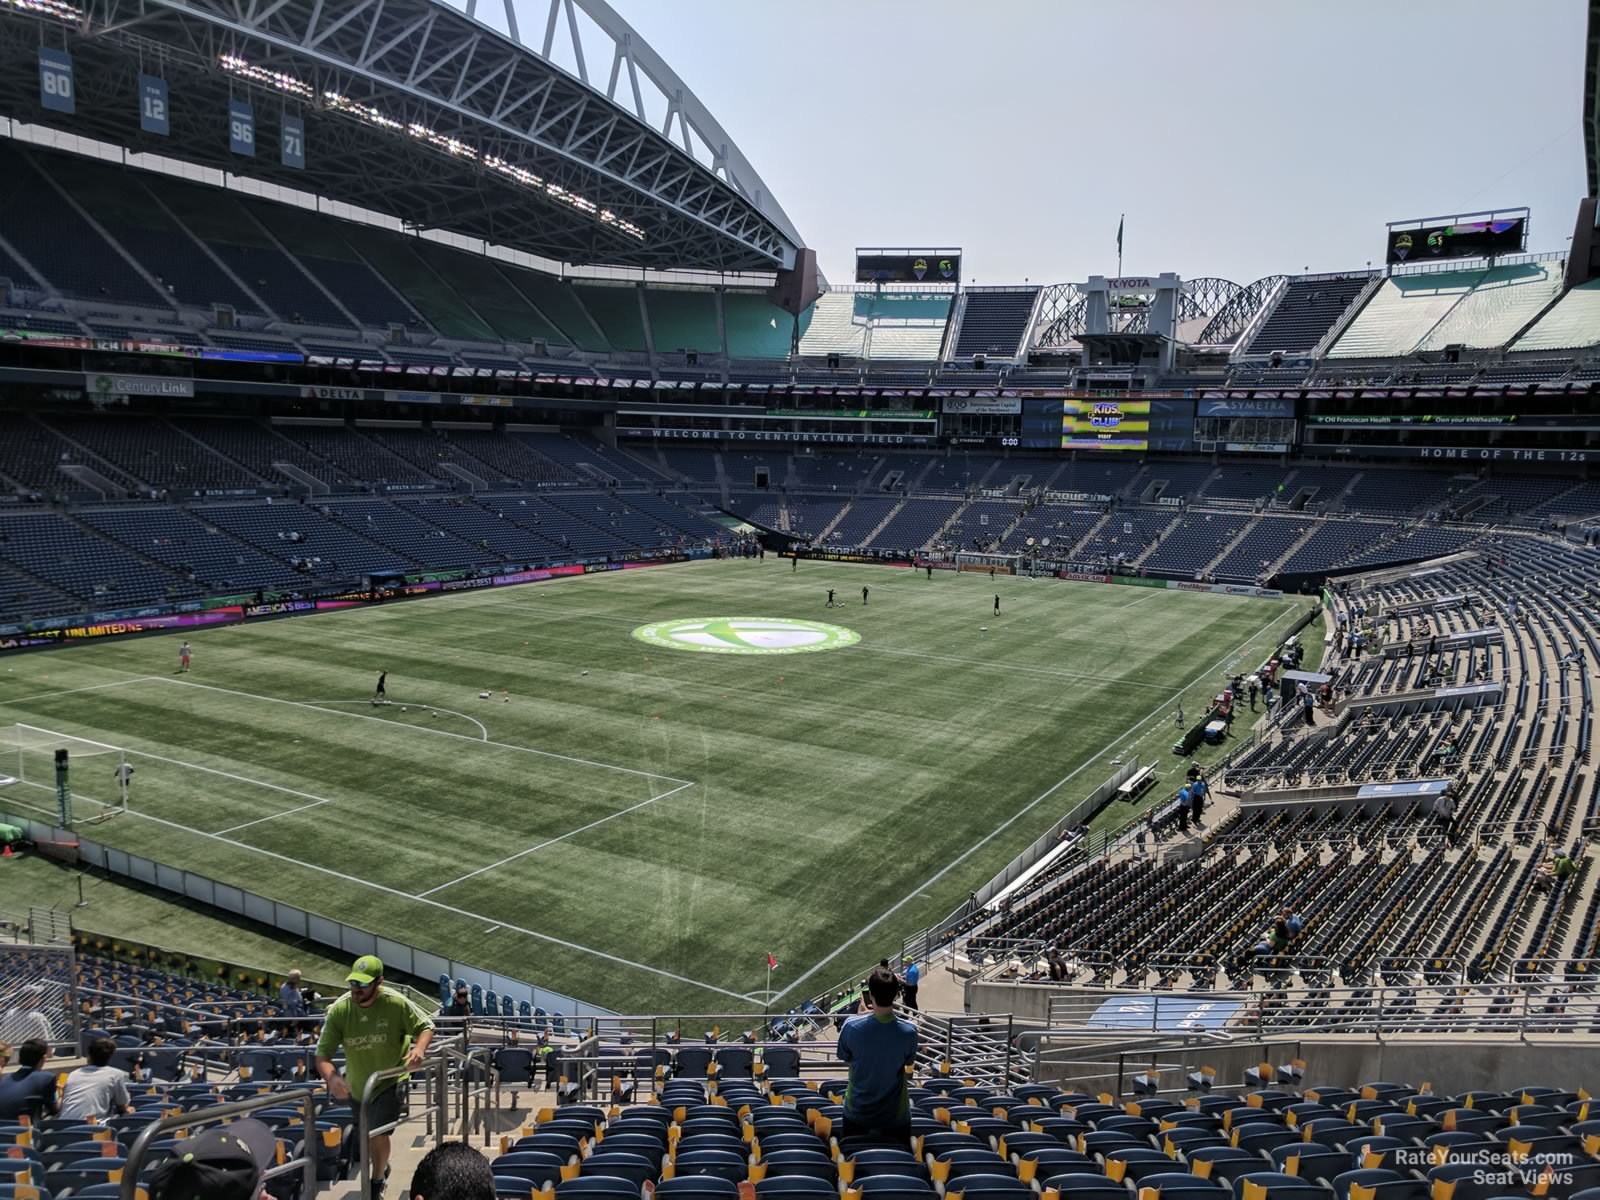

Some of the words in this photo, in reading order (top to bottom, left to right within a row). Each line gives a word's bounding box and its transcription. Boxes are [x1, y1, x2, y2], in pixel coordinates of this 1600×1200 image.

[43, 71, 71, 98] 80
[144, 97, 165, 120] 12
[231, 121, 253, 144] 96
[285, 135, 302, 156] 71
[1107, 279, 1150, 288] TOYOTA
[116, 379, 187, 393] CenturyLink
[320, 389, 360, 398] DELTA
[1093, 402, 1120, 414] KIDS
[1231, 401, 1286, 410] SYMETRA
[1091, 417, 1119, 427] CLUB
[653, 430, 720, 438] WELCOME
[755, 433, 854, 442] CENTURYLINK
[863, 435, 903, 443] FIELD
[1421, 448, 1468, 458] HOME
[1481, 449, 1501, 458] OF
[1513, 450, 1545, 460] THE
[1560, 451, 1586, 461] 12s
[294, 600, 315, 611] BEST
[65, 624, 126, 638] UNLIMITED
